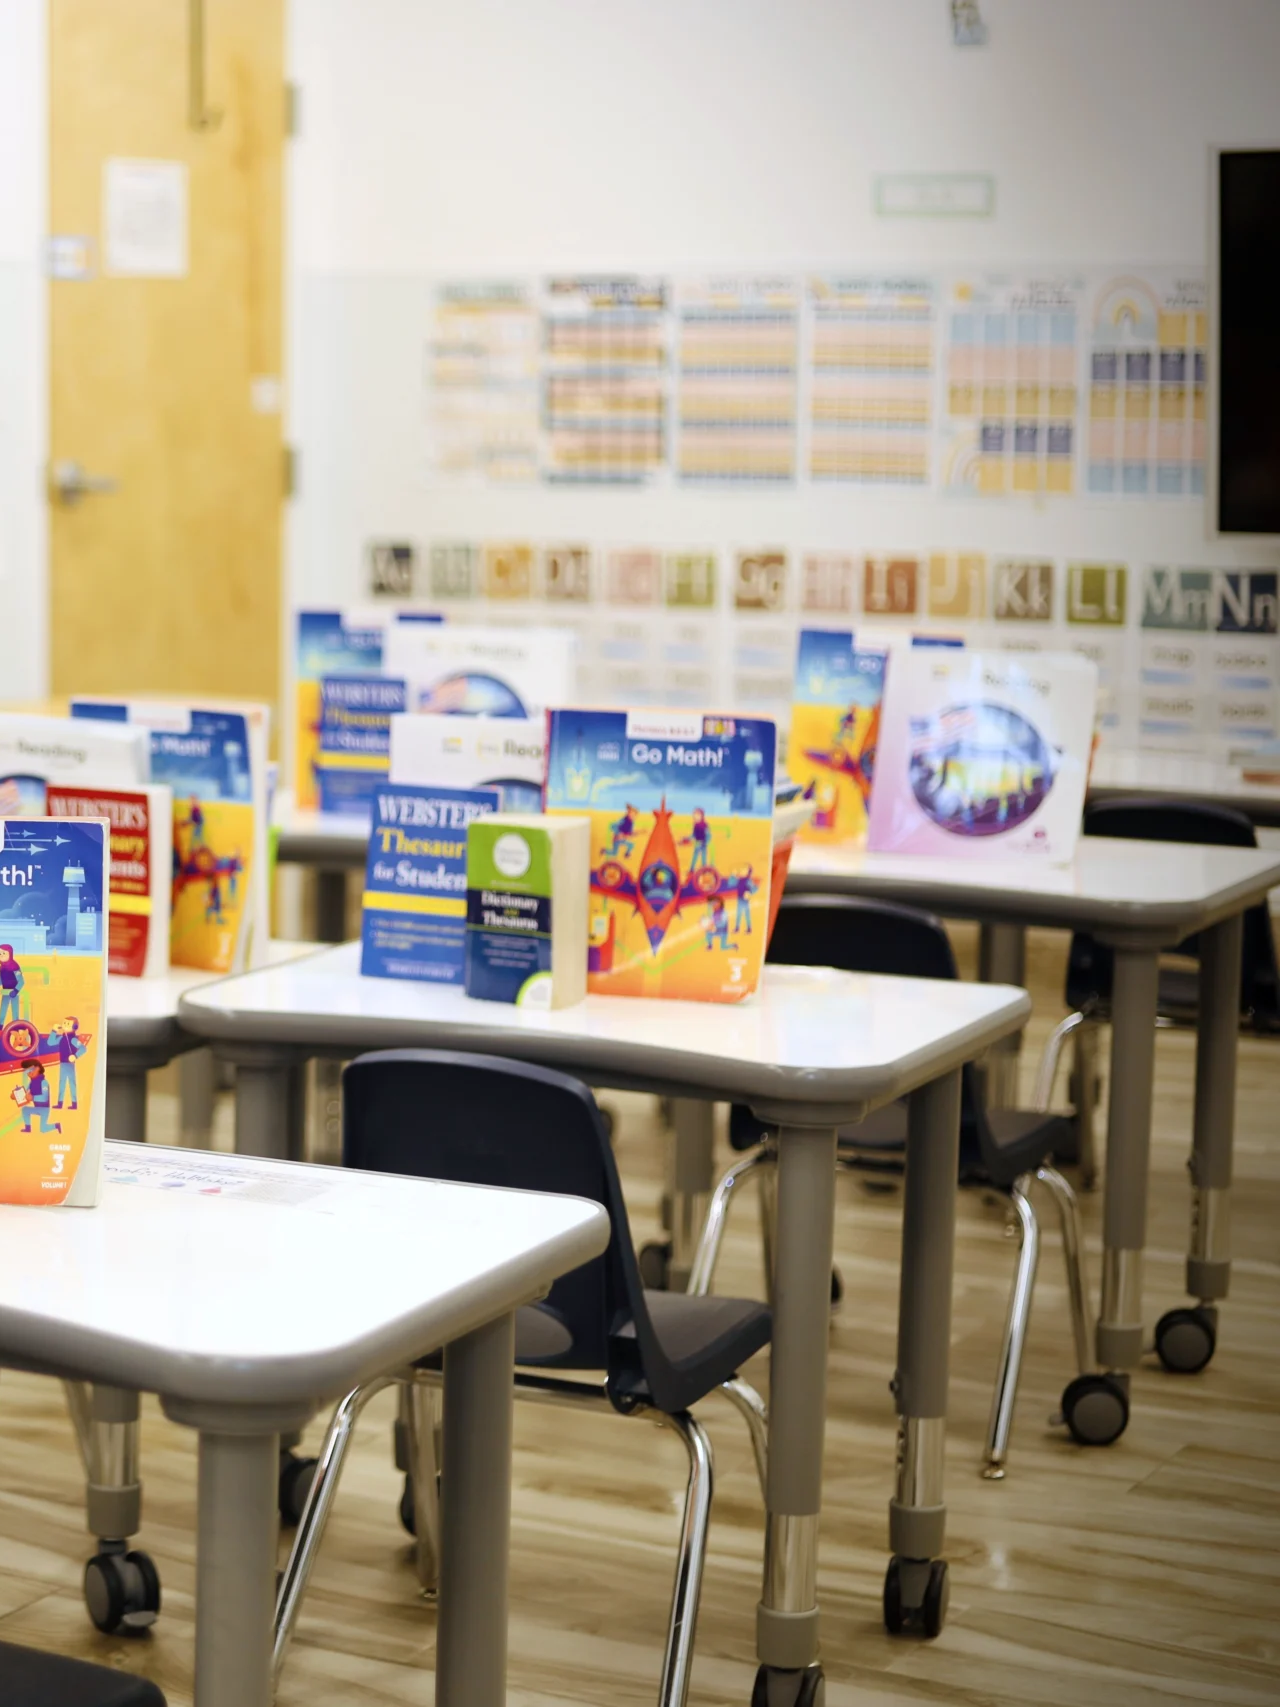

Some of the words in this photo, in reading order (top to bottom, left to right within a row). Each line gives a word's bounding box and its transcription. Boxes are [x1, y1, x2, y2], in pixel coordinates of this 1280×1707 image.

[1000, 563, 1050, 618] Kk
[1073, 563, 1119, 620] Ll
[1143, 566, 1209, 621] Mm
[1215, 570, 1279, 627] Nn
[632, 743, 662, 764] Go
[666, 745, 724, 768] Math!
[376, 826, 465, 859] Thesaur
[396, 860, 467, 891] Studen
[482, 890, 539, 913] Dictionary
[483, 910, 539, 931] Thesaurus
[51, 1153, 65, 1175] 3
